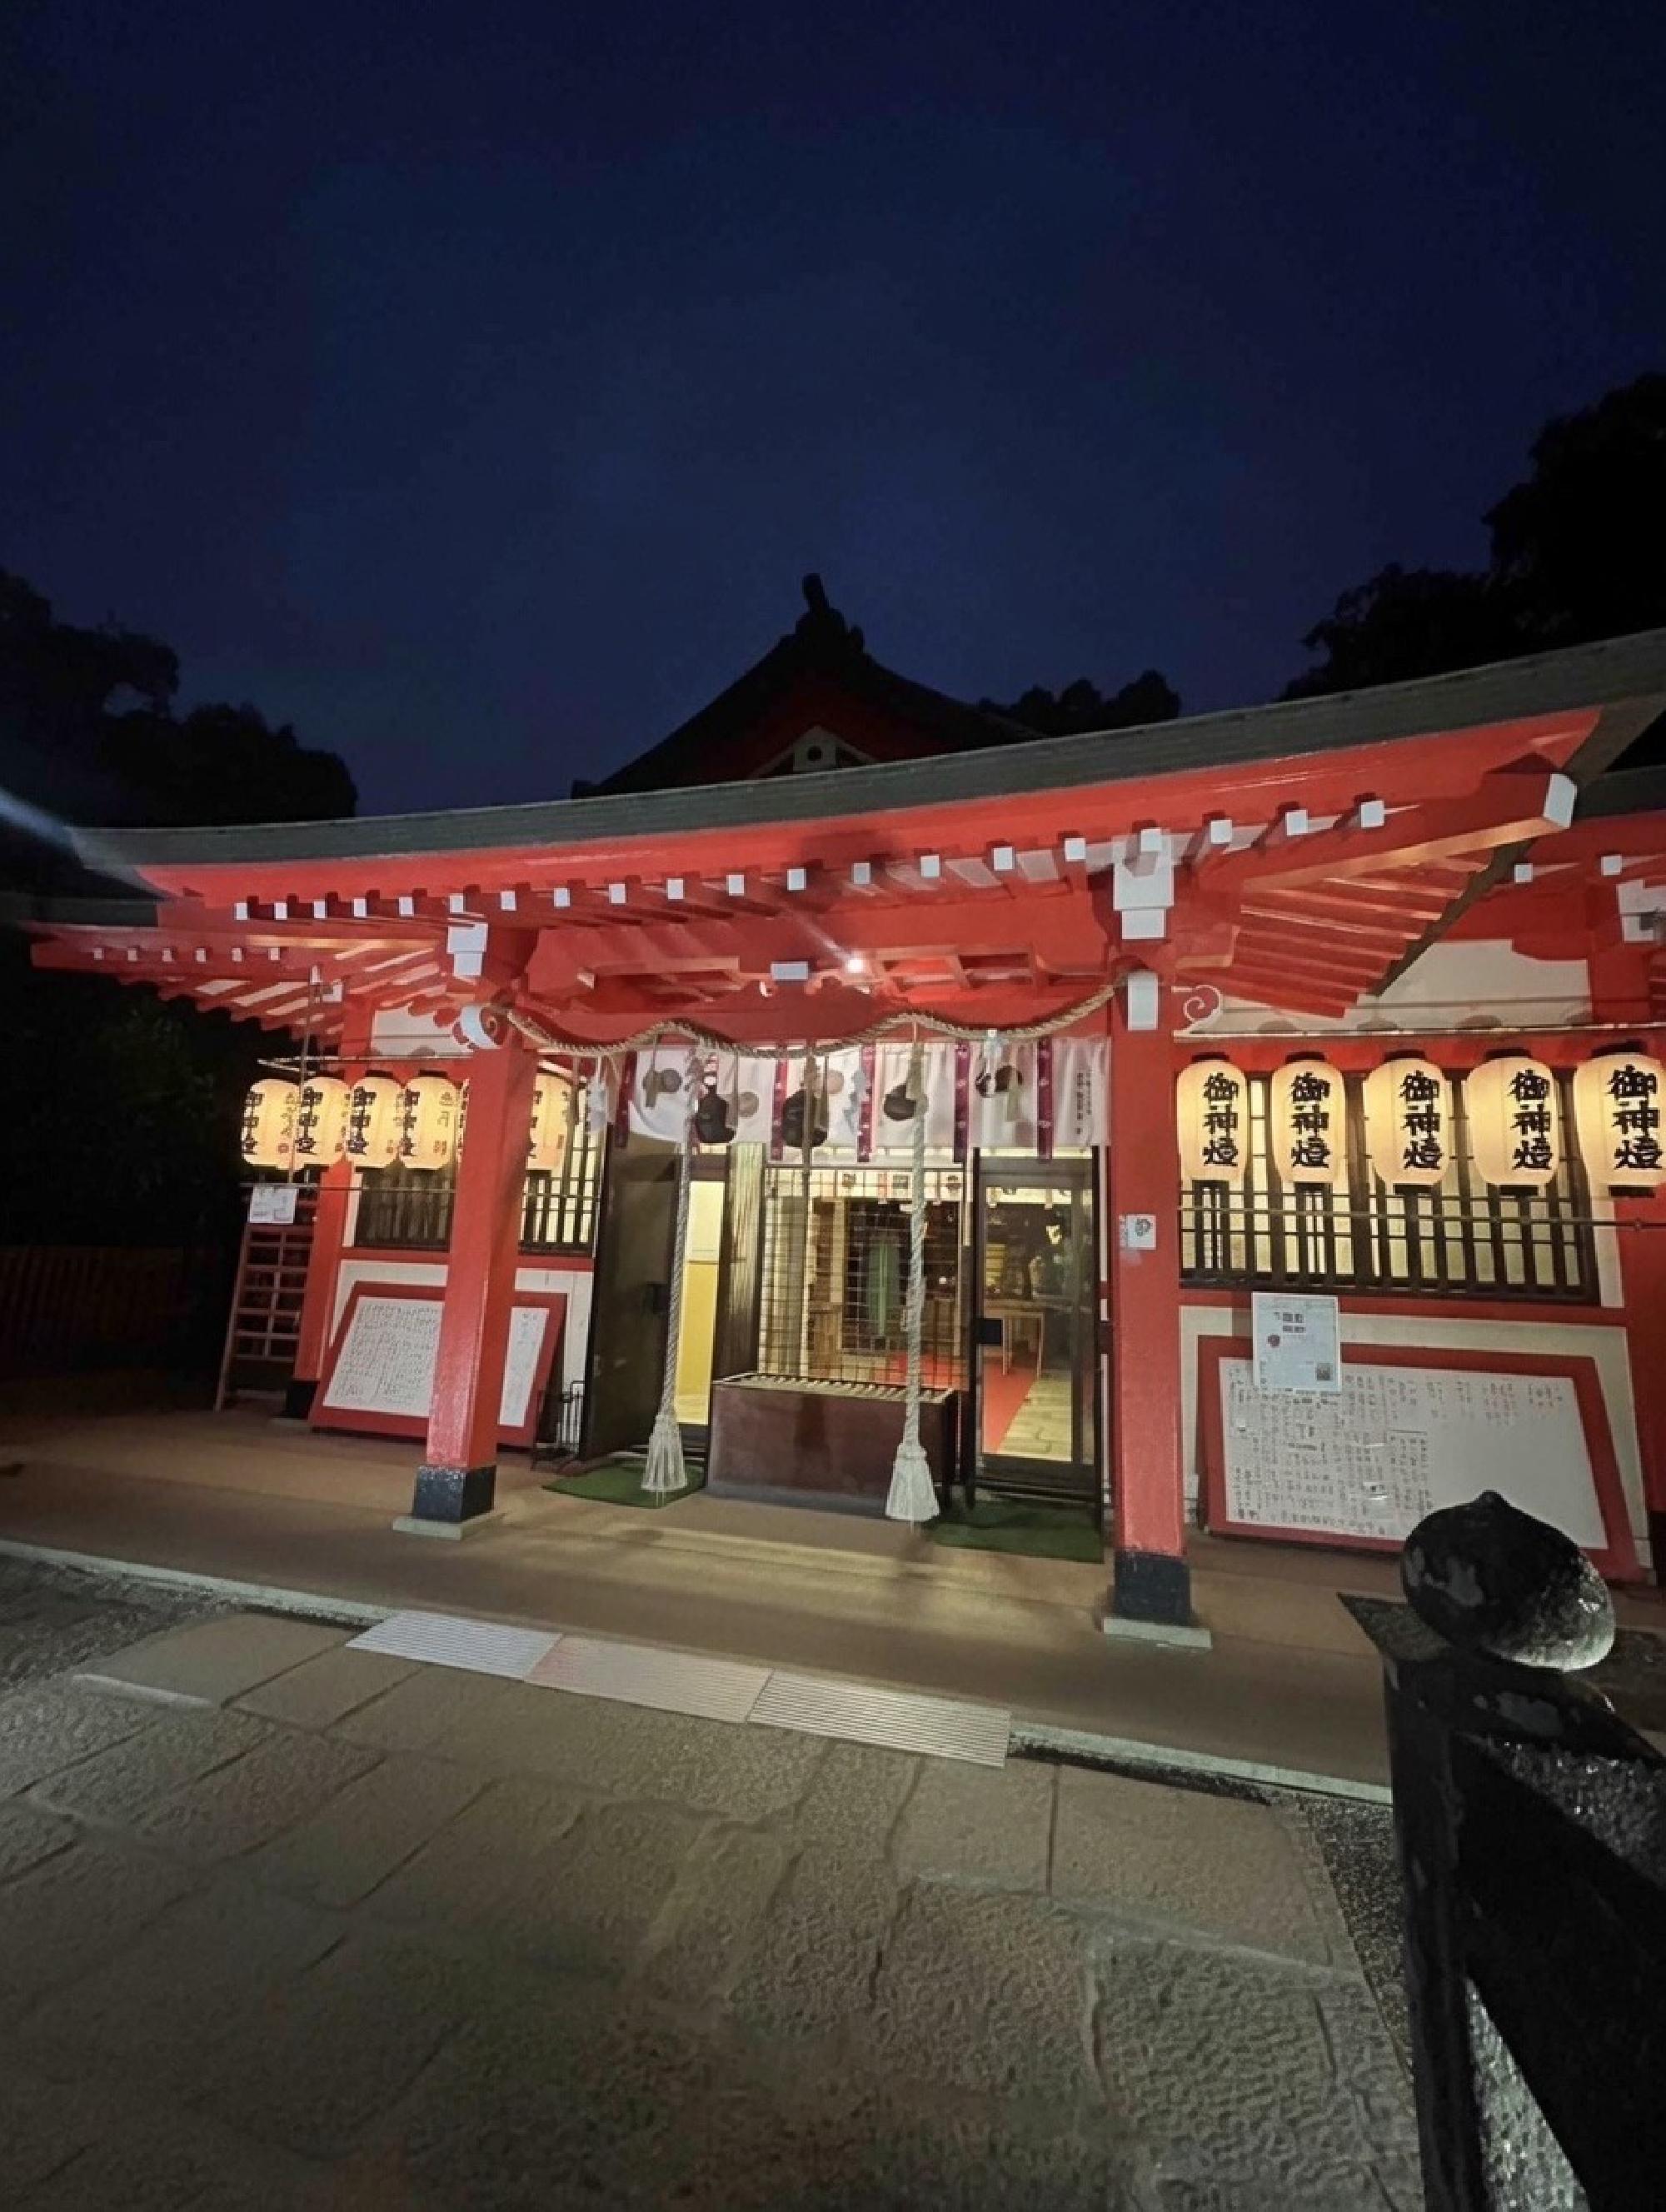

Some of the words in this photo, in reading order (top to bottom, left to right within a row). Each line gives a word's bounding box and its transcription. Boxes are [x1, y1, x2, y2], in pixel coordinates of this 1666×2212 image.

[1203, 1071, 1240, 1166] 御神燈
[1290, 1071, 1331, 1168] 御神燈
[1399, 1070, 1444, 1169] 御神燈
[1508, 1069, 1554, 1170] 御神燈
[1606, 1064, 1663, 1169] 御神燈
